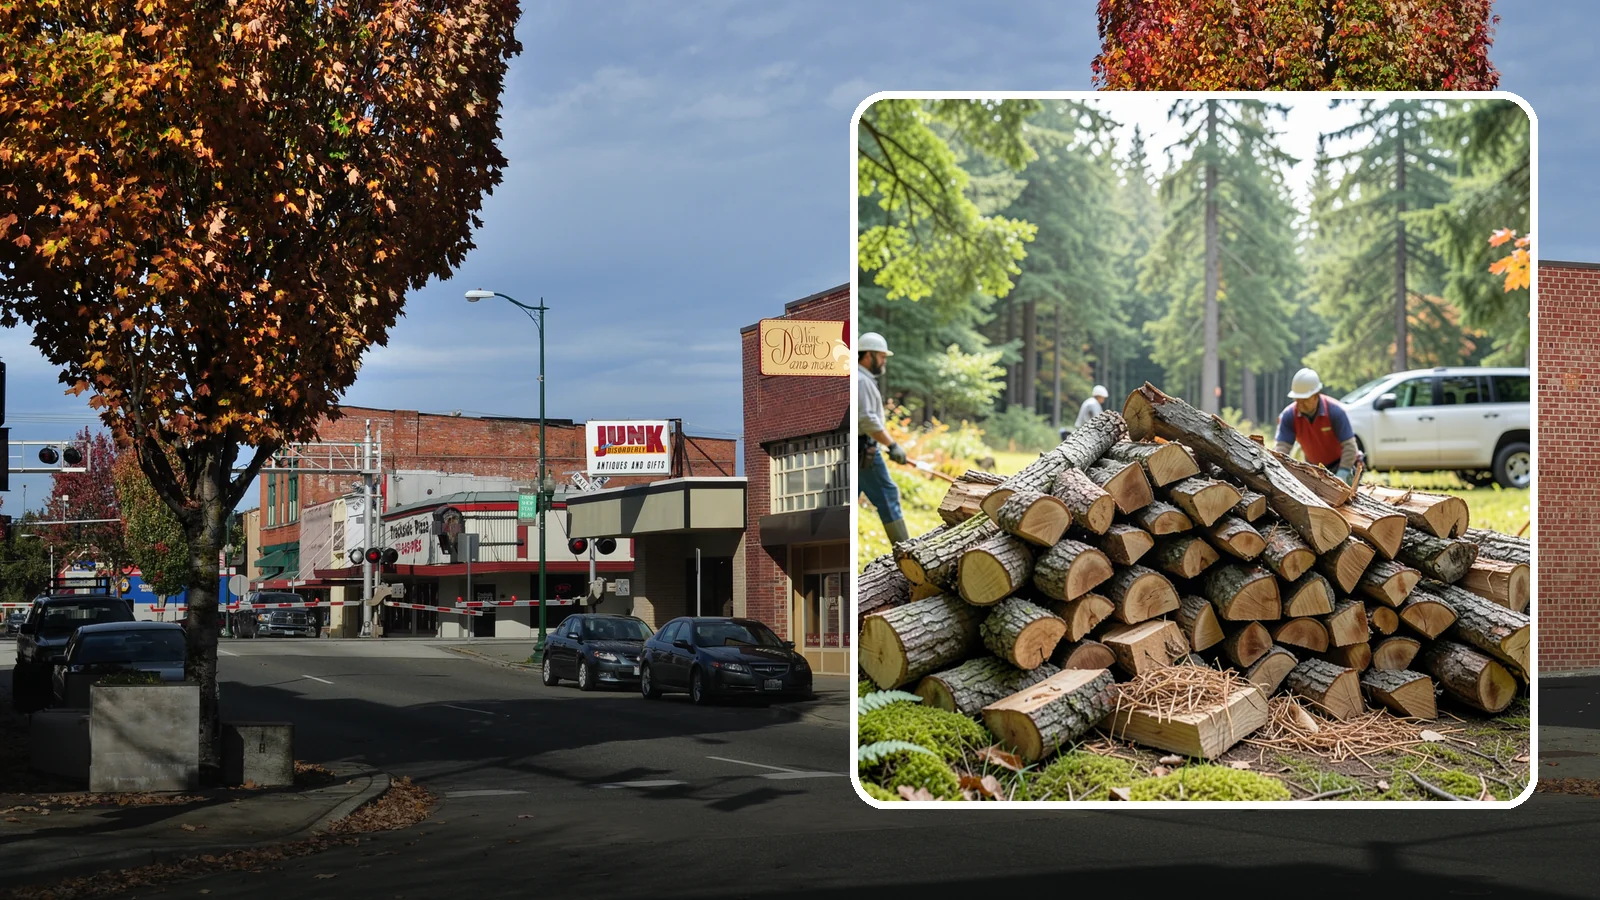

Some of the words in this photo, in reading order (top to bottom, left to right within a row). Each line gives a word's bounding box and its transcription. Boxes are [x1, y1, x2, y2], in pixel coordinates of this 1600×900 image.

[595, 425, 665, 457] JUNK
[596, 461, 628, 470] ANTIQUES
[631, 461, 644, 470] AND
[647, 460, 665, 469] GIFTS
[390, 521, 413, 539] Trackside
[414, 519, 429, 534] Pizza
